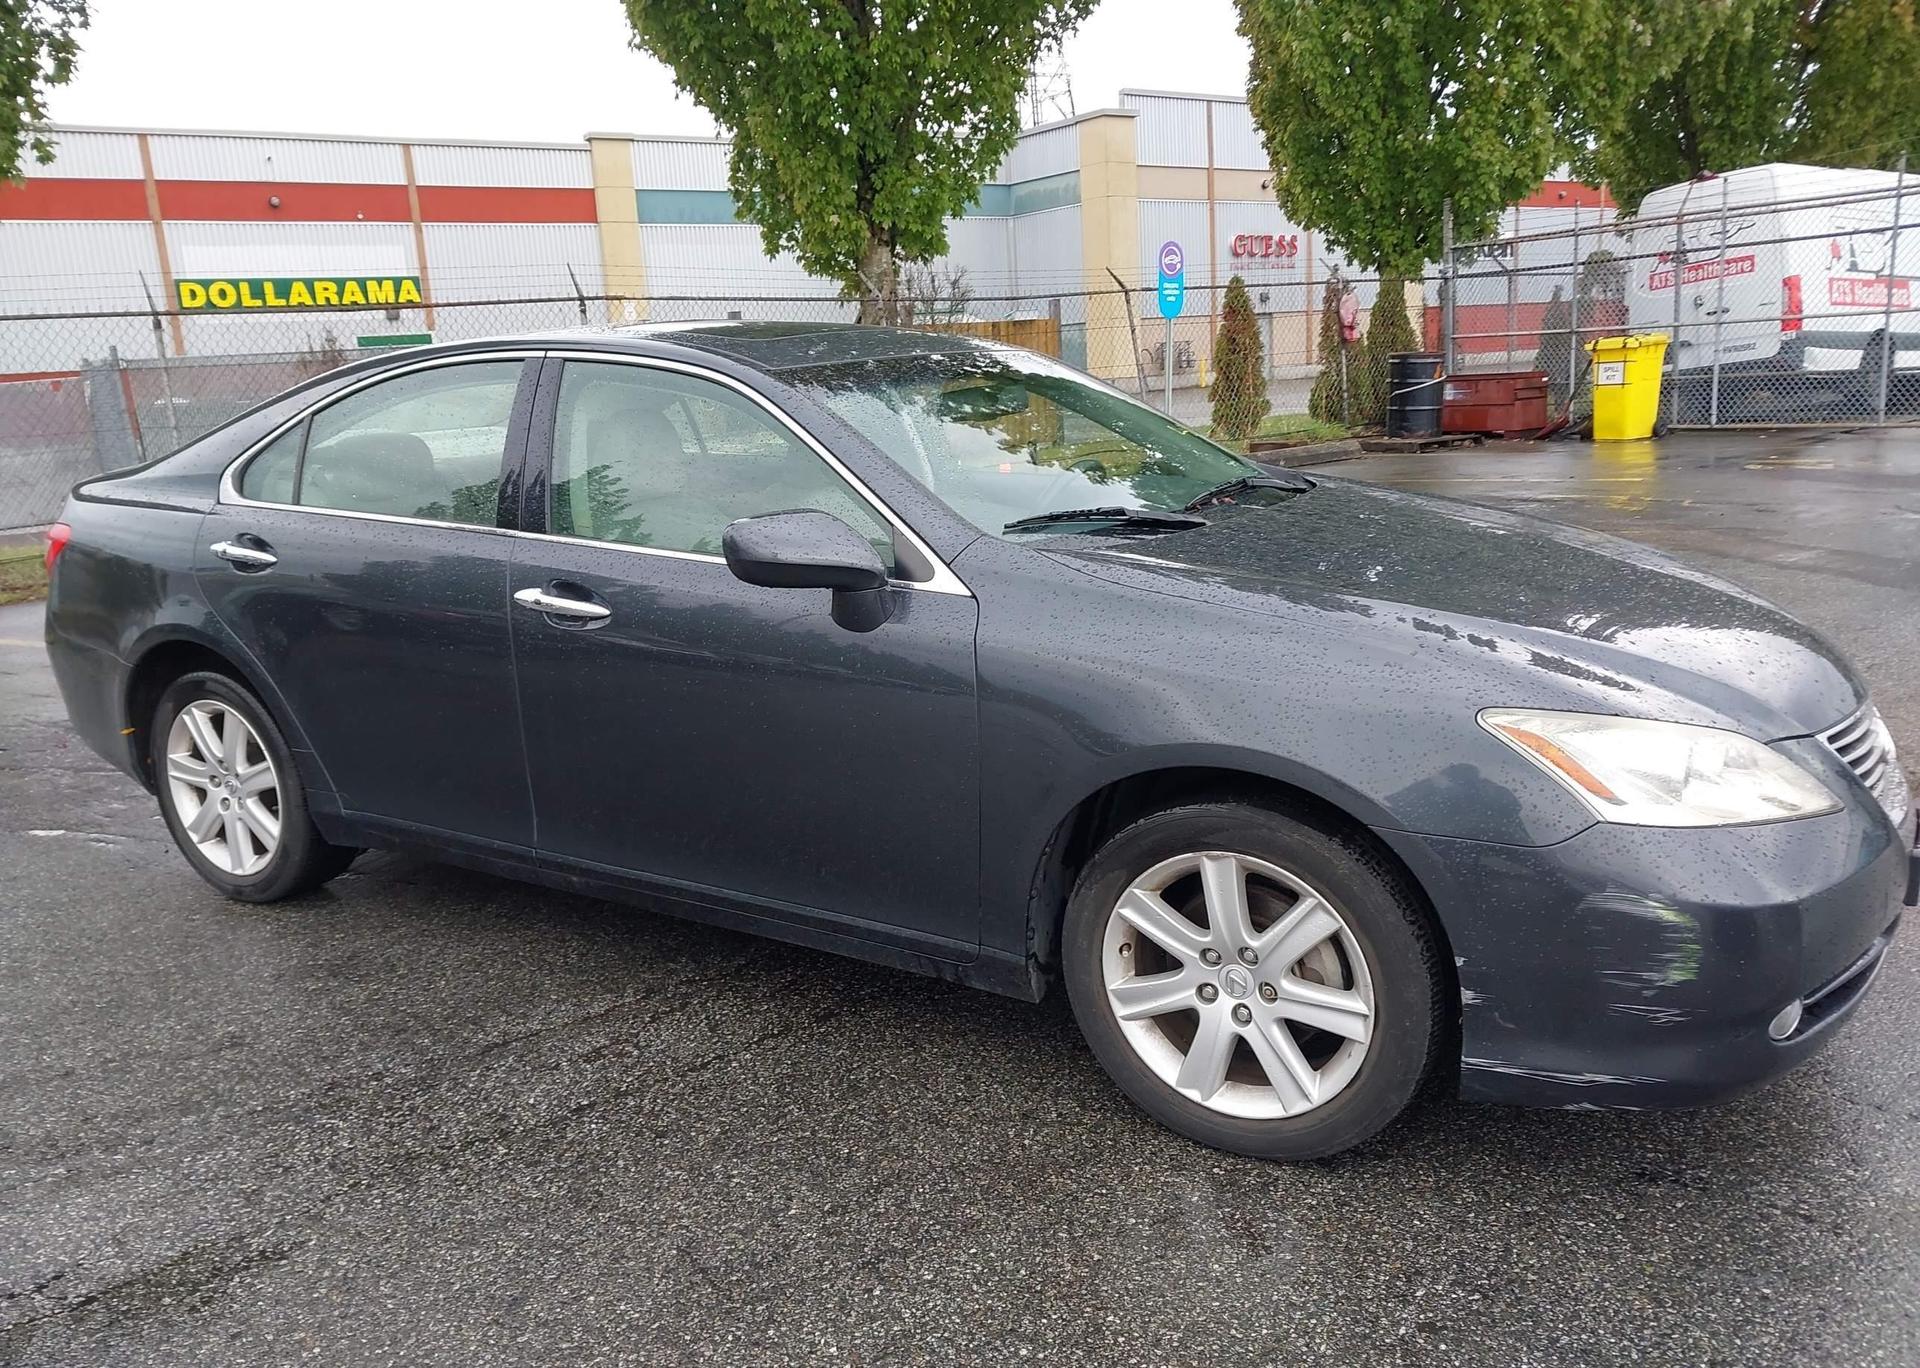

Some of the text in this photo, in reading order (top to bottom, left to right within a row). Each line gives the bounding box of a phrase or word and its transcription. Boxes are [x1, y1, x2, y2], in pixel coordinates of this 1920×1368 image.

[1233, 233, 1298, 257] GUESS
[1651, 272, 1675, 290] ATS
[178, 279, 422, 309] DOLLARAMA
